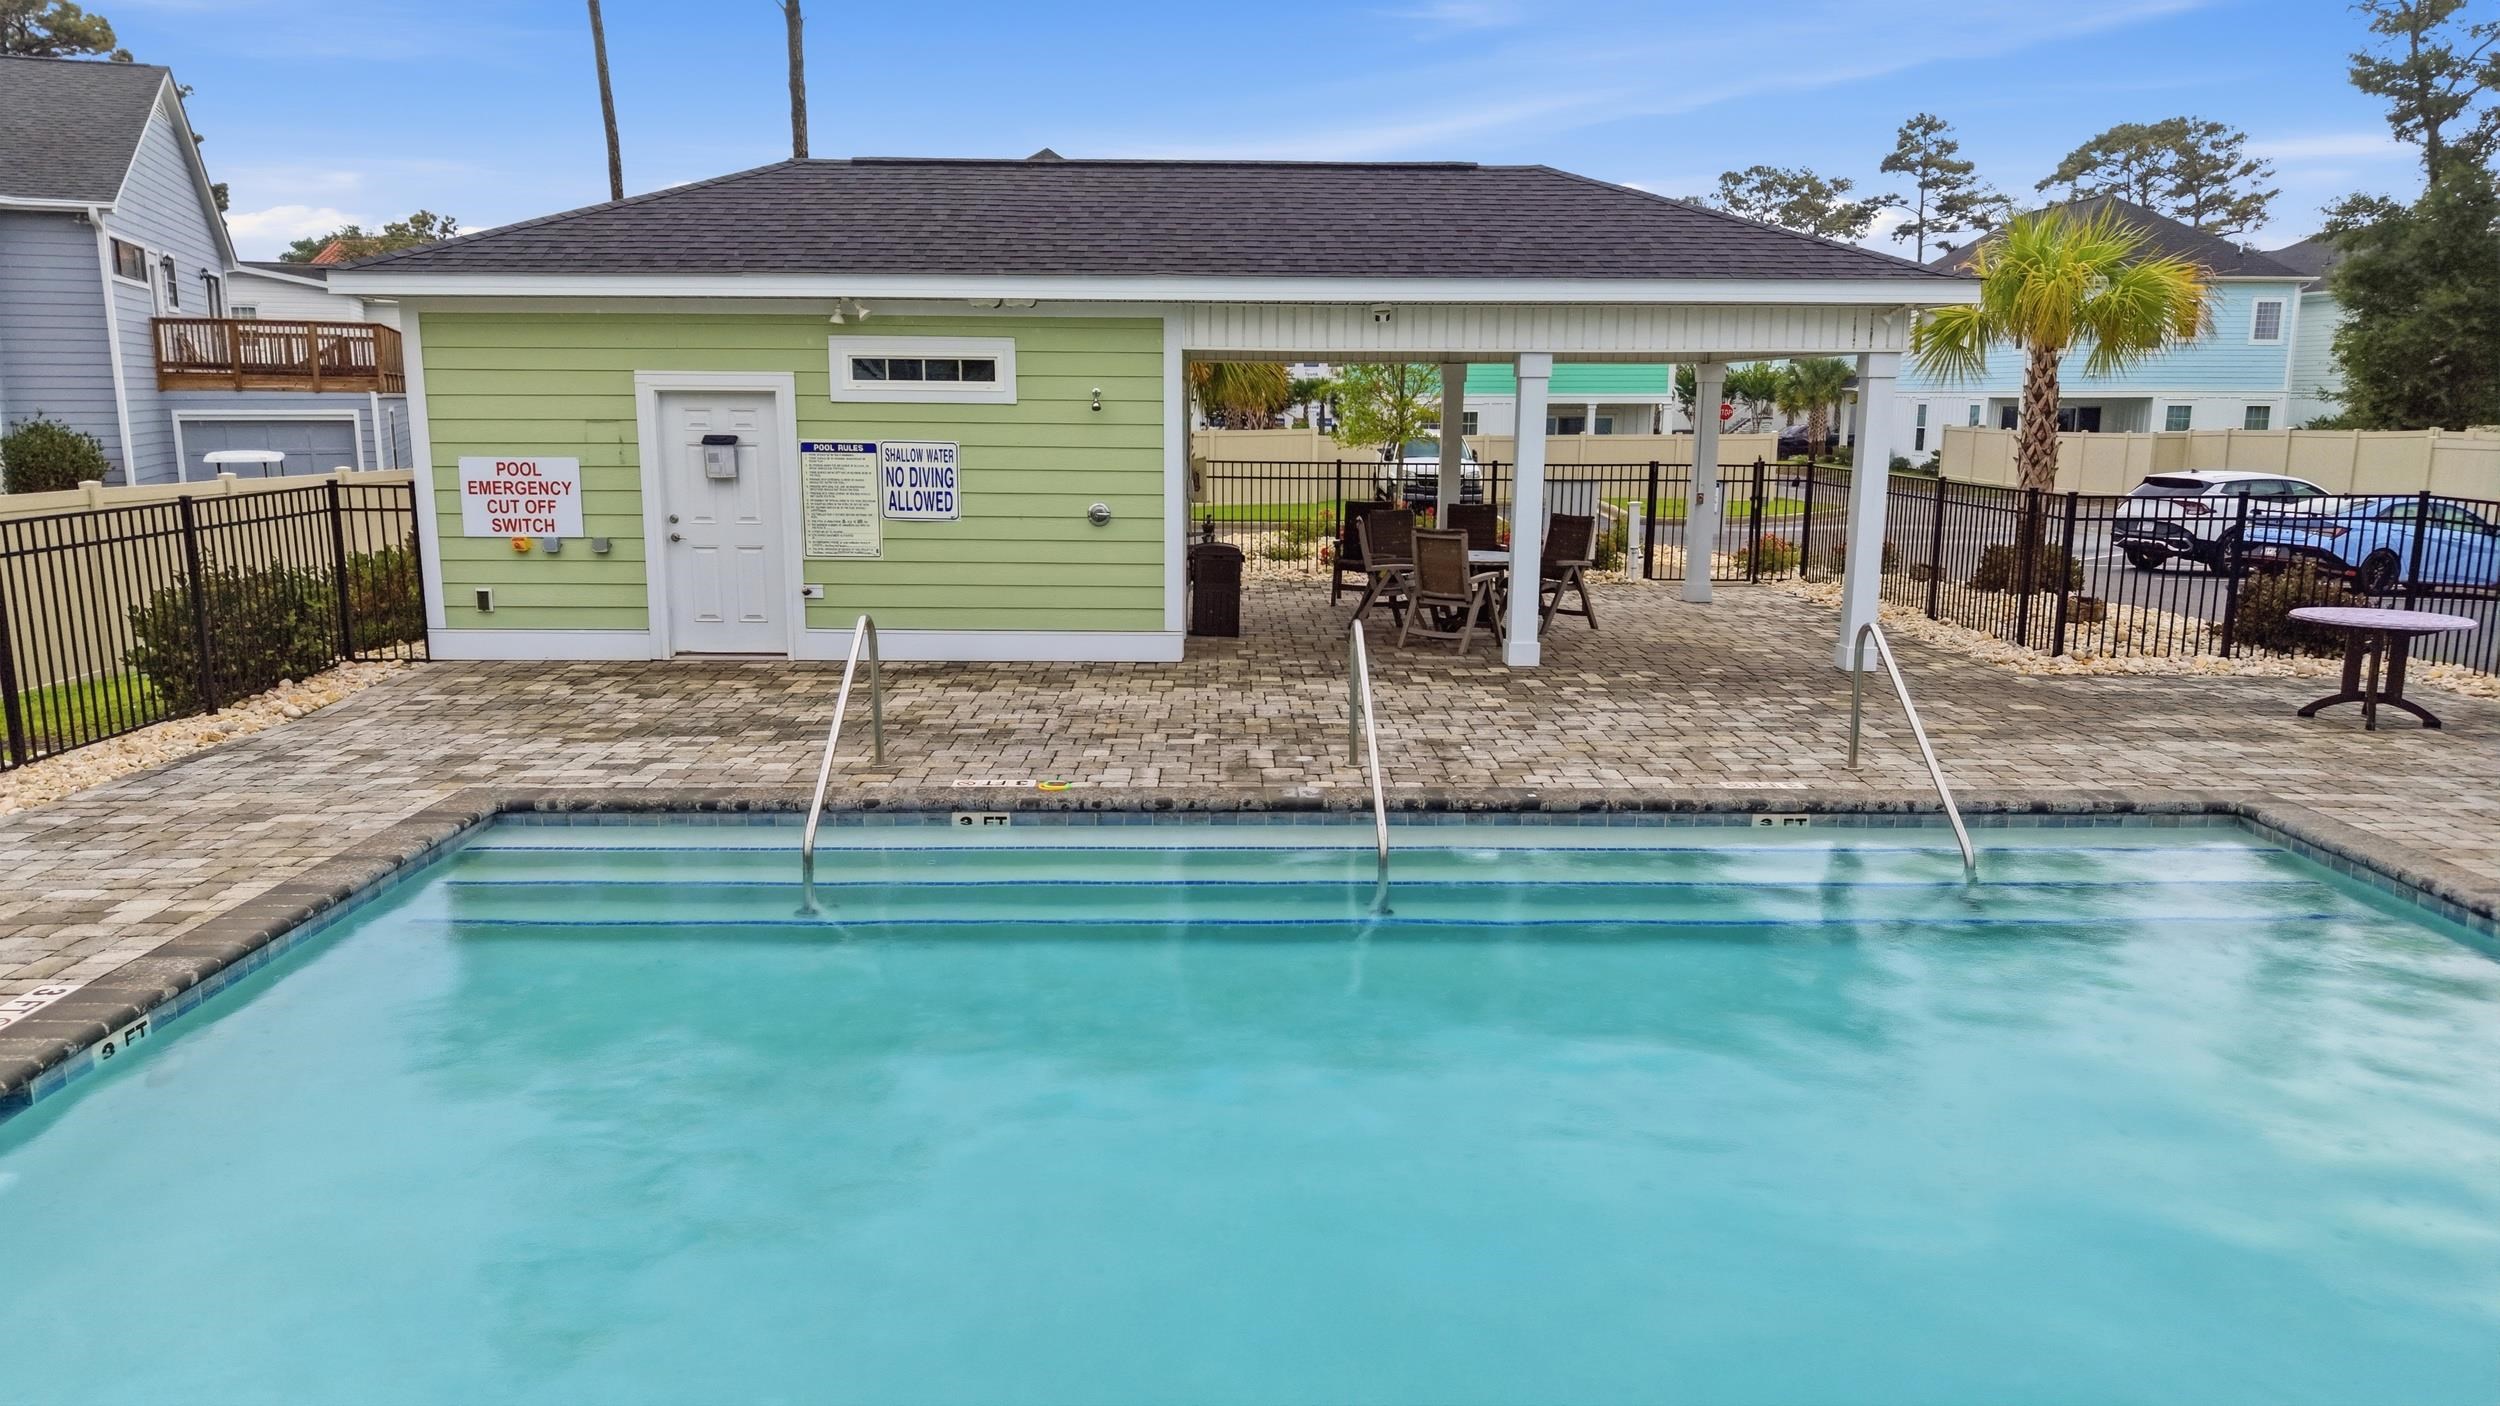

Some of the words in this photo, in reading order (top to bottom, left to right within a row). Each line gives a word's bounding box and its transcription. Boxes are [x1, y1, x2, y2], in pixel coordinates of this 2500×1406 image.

[813, 444, 834, 452] POOL
[837, 444, 864, 452] RULES
[885, 447, 923, 462] SHALLOW
[926, 448, 954, 463] WATER
[496, 462, 542, 476] POOL
[886, 466, 904, 488] NO
[909, 466, 954, 488] DIVING
[468, 480, 572, 495] EMERGENCY
[487, 499, 520, 514] CUT
[525, 499, 556, 514] OFF
[888, 490, 953, 512] ALLOWED
[492, 518, 555, 533] SWITCH
[960, 816, 973, 826] 3
[983, 816, 1008, 826] FT
[1760, 818, 1773, 826] 3
[1783, 818, 1808, 826] FT
[32, 988, 68, 996] 3
[102, 1042, 115, 1060] 3
[125, 1020, 148, 1047] FT
